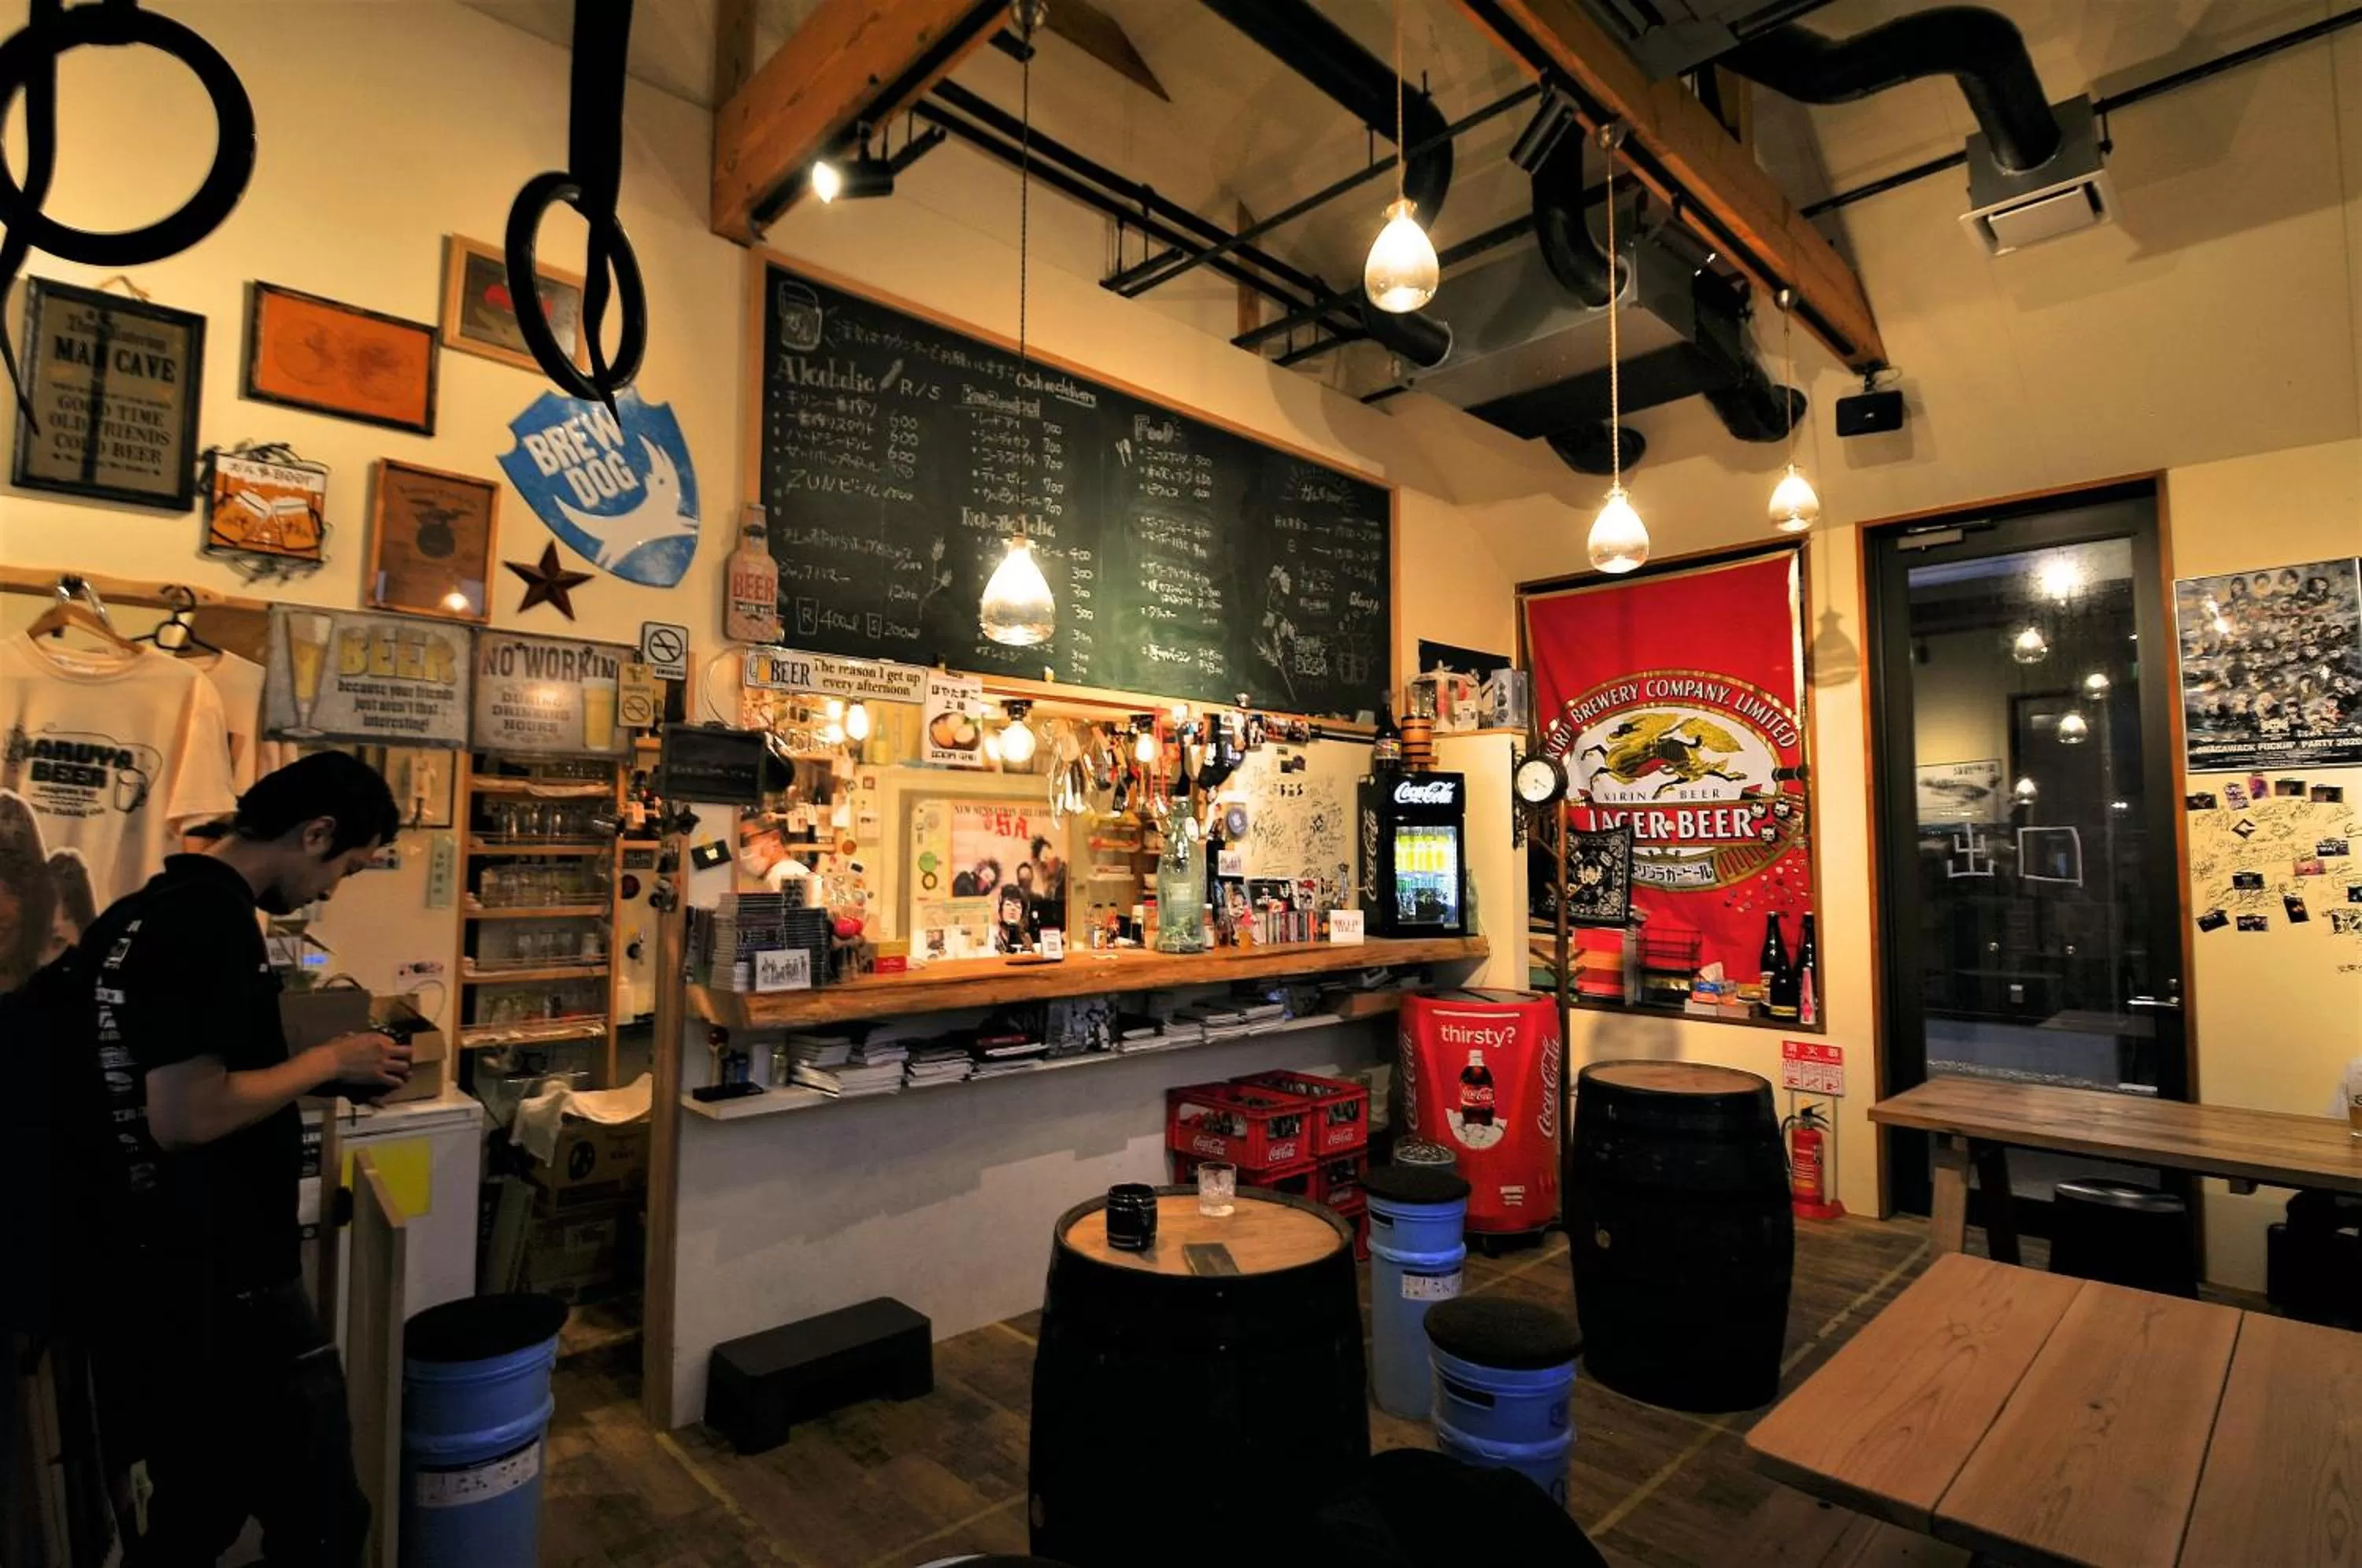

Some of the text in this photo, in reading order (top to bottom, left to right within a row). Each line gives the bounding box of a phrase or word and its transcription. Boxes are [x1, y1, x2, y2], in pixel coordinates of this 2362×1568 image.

[115, 349, 176, 383] CAVE
[117, 404, 164, 426] TIME
[101, 420, 172, 446] RIENDS
[522, 409, 626, 478] BREW
[113, 442, 162, 464] BEER
[565, 448, 640, 509] DOG
[733, 573, 776, 602] BEER
[338, 624, 457, 686] BEER
[482, 645, 618, 682] NO WORKIN
[771, 658, 811, 686] BEER
[813, 657, 835, 673] The
[837, 664, 876, 679] reason
[887, 669, 904, 682] get
[906, 673, 920, 686] up
[338, 679, 387, 695] because
[415, 685, 454, 701] friends
[502, 690, 561, 707] DURING
[822, 676, 912, 697] every afternoon
[491, 704, 572, 722] DRINKING
[503, 718, 559, 733] HOURS
[1572, 682, 1639, 723] BREWERY
[1734, 693, 1798, 749] LIMITED
[2301, 738, 2334, 749] PARTY
[31, 760, 108, 789] BEER
[1393, 780, 1457, 804] Coca-Cola
[1602, 788, 1722, 801] KIRIN BEER
[1677, 808, 1755, 839] BEER
[1947, 823, 2082, 887] 出口
[1440, 1024, 1516, 1048] thirsty?
